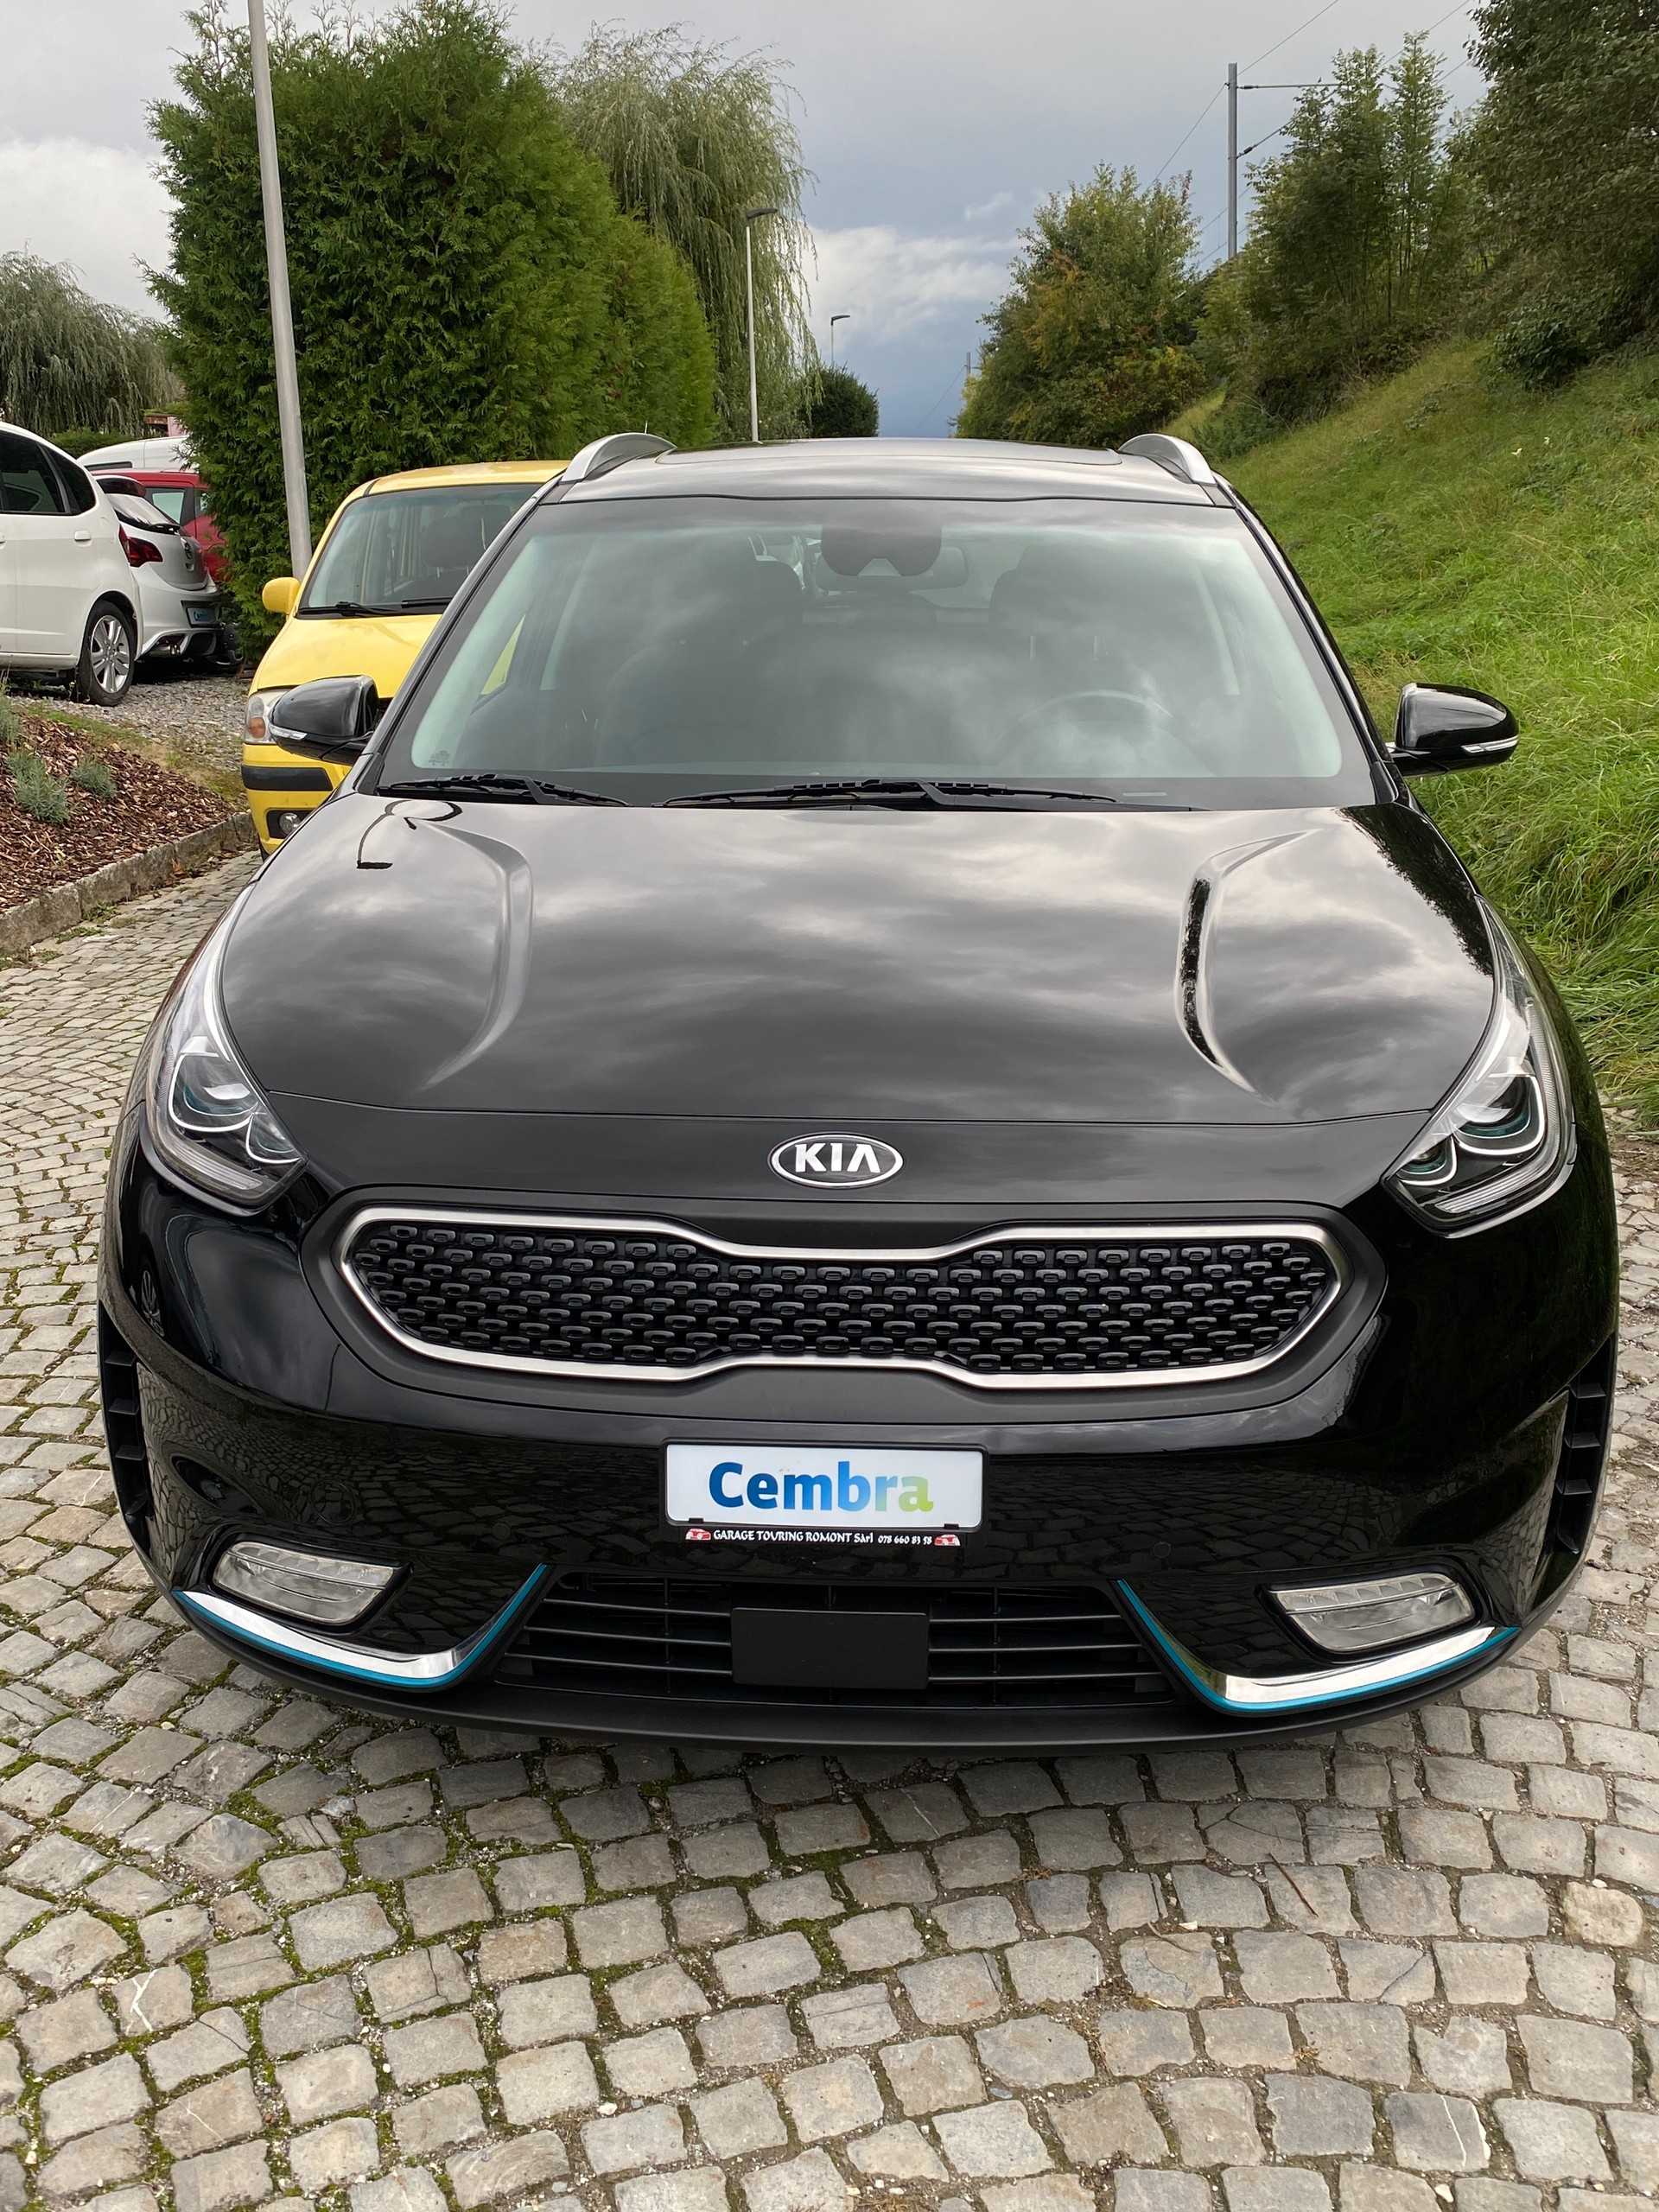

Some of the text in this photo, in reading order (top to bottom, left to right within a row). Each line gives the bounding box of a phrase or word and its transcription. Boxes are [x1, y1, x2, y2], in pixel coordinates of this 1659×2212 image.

[794, 1142, 881, 1173] KIA
[709, 1461, 934, 1512] Cembra
[713, 1529, 755, 1541] GARAGE
[756, 1530, 804, 1541] TOURING
[805, 1531, 853, 1542] ROMONT
[877, 1535, 893, 1544] 078
[893, 1535, 910, 1544] 660
[912, 1535, 921, 1545] 83
[923, 1535, 932, 1545] 58
